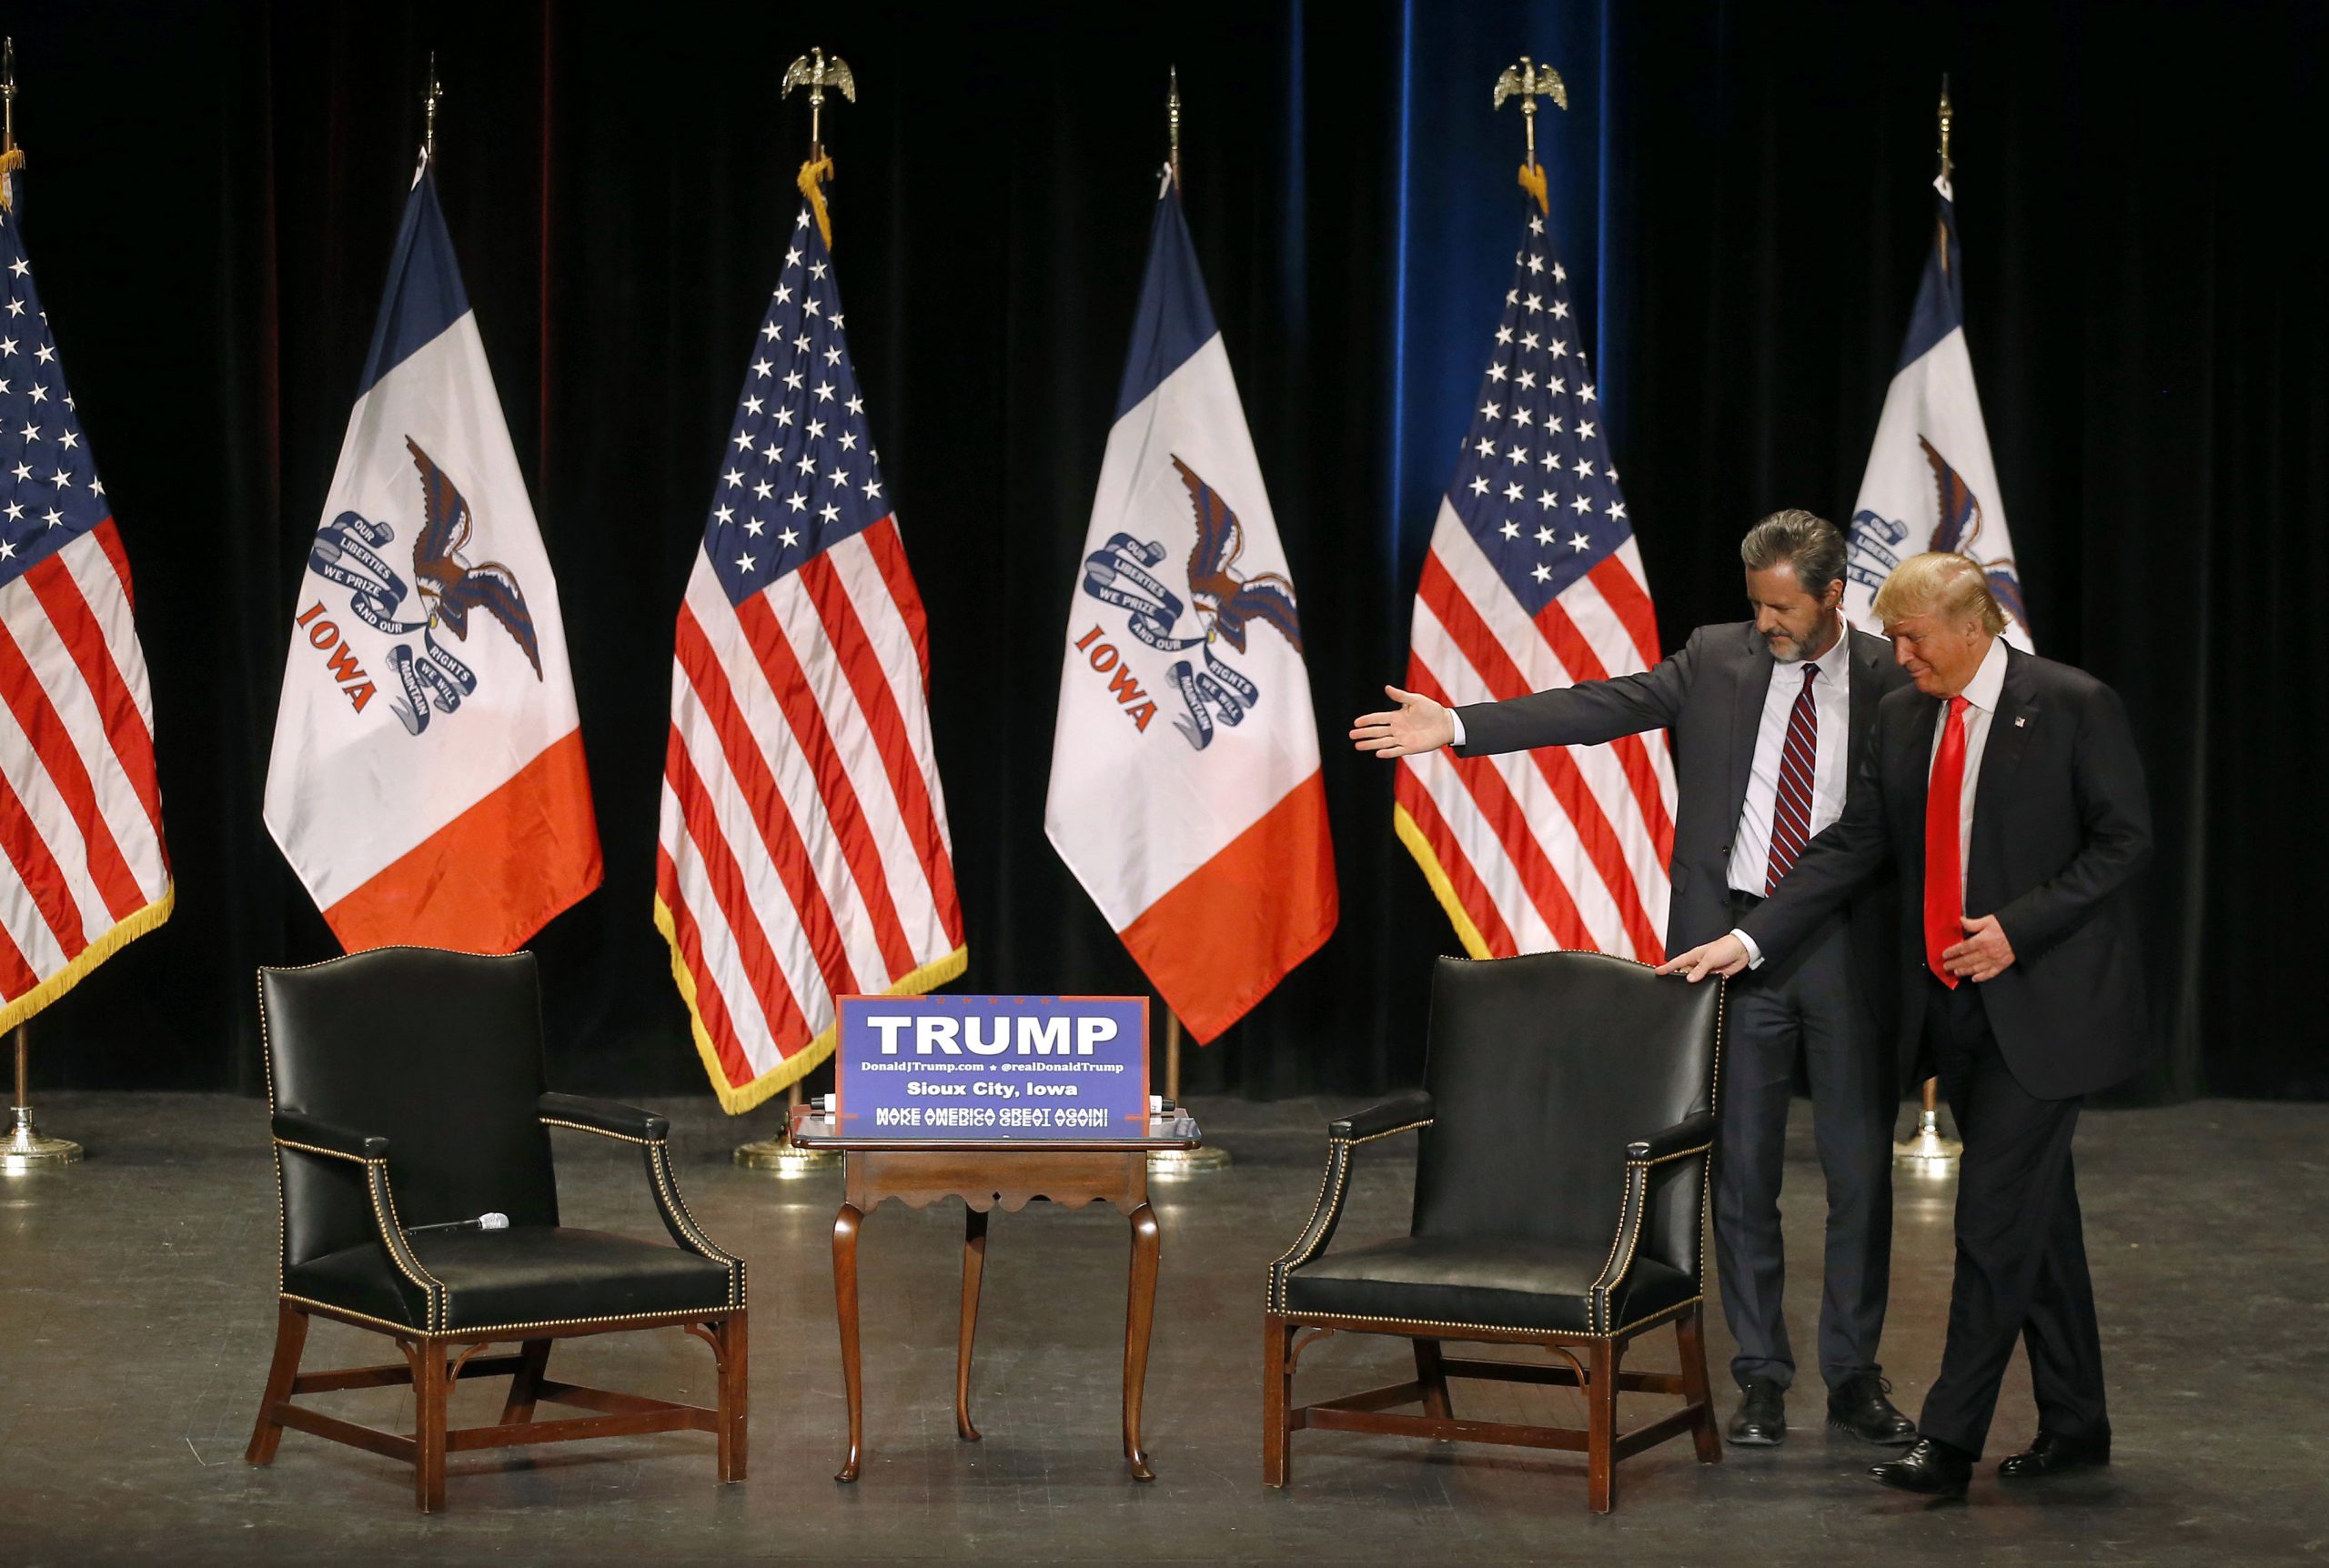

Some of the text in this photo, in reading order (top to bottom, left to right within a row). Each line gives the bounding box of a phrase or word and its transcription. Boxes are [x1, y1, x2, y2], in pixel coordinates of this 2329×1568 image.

[354, 519, 376, 542] OUR
[339, 537, 391, 579] LIBERTIES
[1126, 540, 1149, 562] OUR
[324, 564, 381, 598] WE PRIZE
[1114, 558, 1166, 598] LIBERTIES
[355, 602, 403, 634] AND OUR
[1099, 587, 1158, 617] WE PRIZE
[1131, 622, 1183, 651] AND OUR
[296, 599, 378, 714] IOWA
[429, 645, 470, 682] RIGHTS
[399, 659, 428, 716] MAINTAIN
[421, 663, 456, 705] WE WILL
[1074, 622, 1159, 734] IOWA
[1209, 659, 1253, 695] RIGHTS
[1181, 675, 1212, 731] MAINTAIN
[1202, 678, 1239, 719] WE WILL
[867, 1016, 1118, 1055] TRUMP
[862, 1061, 1124, 1074] DonaldJTrump.com @realDonaldTrump
[907, 1081, 1078, 1099] Sioux City, Iowa
[876, 1107, 921, 1118] MAKE
[923, 1107, 996, 1118] AMERICA
[999, 1108, 1052, 1118] GREAT
